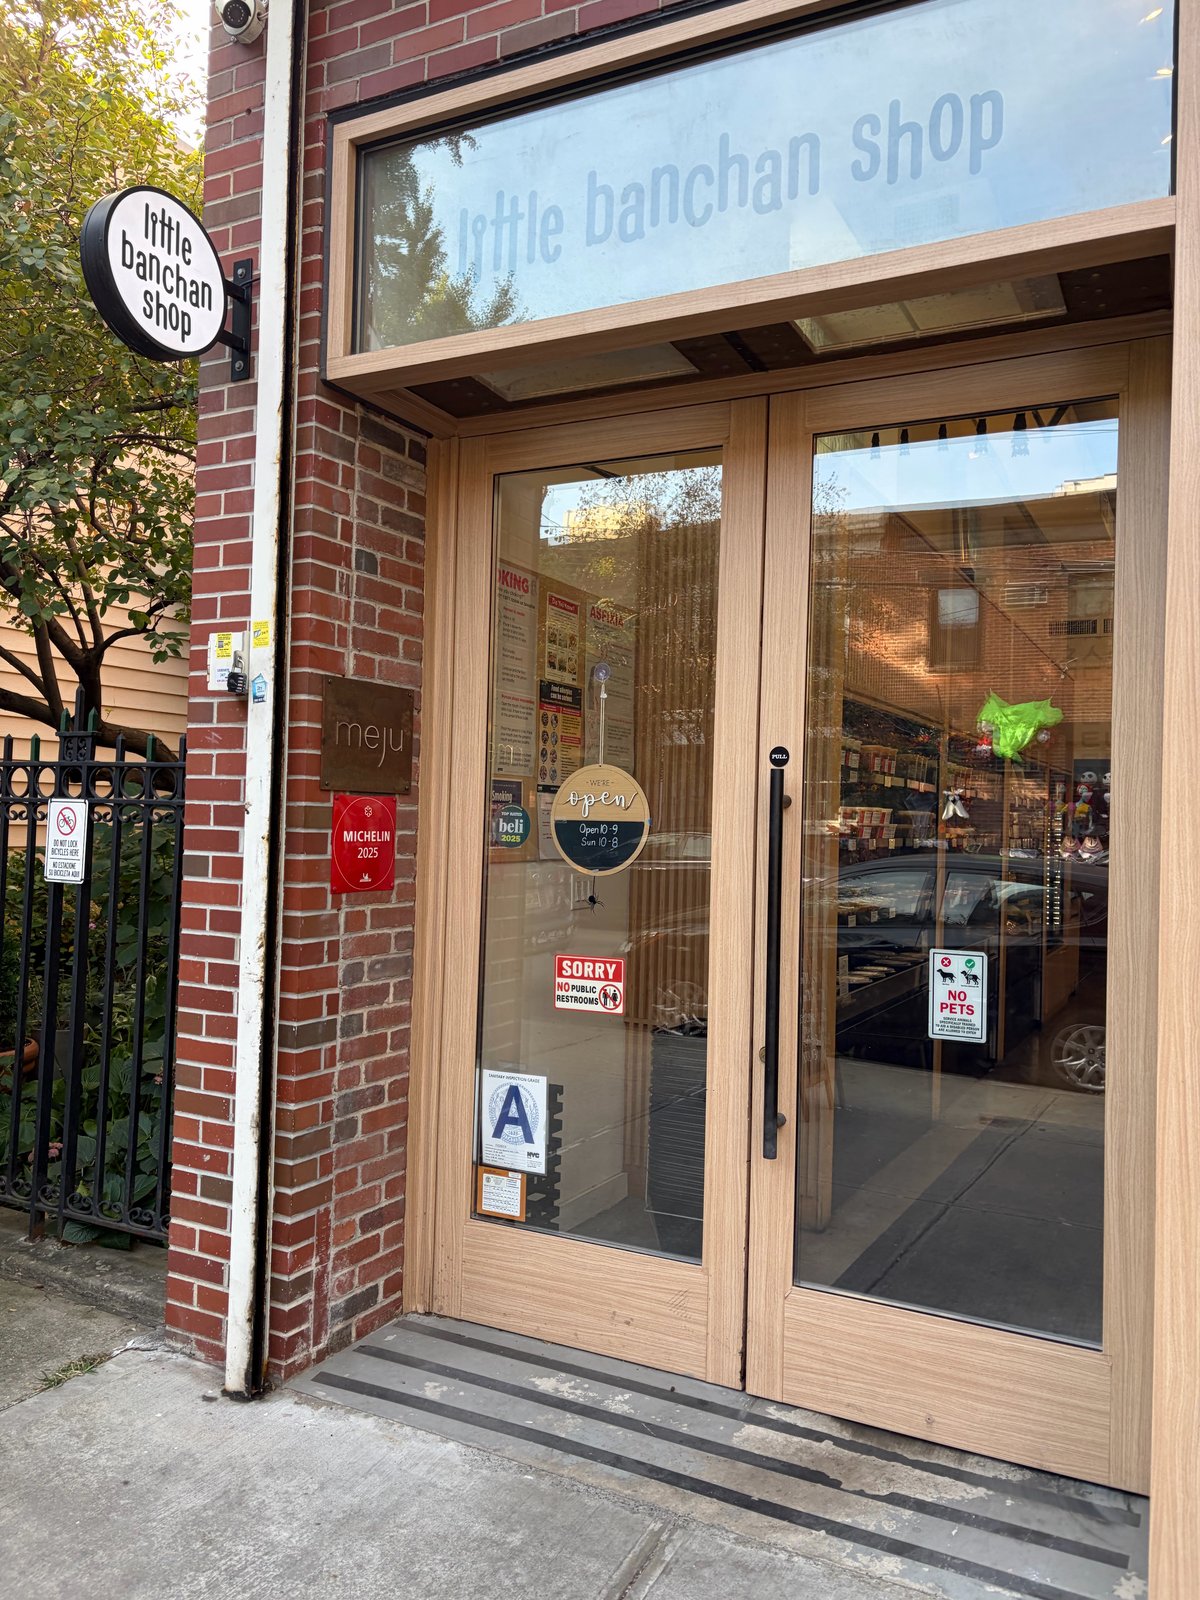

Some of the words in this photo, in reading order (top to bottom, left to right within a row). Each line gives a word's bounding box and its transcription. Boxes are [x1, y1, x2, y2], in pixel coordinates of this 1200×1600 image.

[458, 189, 565, 284] little
[585, 132, 821, 247] banchan
[850, 89, 1004, 185] shop
[144, 202, 192, 266] little
[121, 229, 212, 312] banchan
[142, 289, 192, 343] shop
[335, 721, 404, 768] meju
[563, 790, 638, 818] open
[499, 818, 524, 834] beli
[579, 823, 599, 837] Open
[343, 830, 391, 842] MICHELIN
[501, 834, 521, 843] 2025
[581, 836, 596, 847] Sun
[53, 839, 59, 847] DO
[68, 840, 78, 848] LOCK
[51, 848, 69, 856] BICYCLES
[70, 849, 80, 857] HERE
[357, 847, 379, 859] 2025
[562, 960, 617, 980] SORRY
[557, 982, 570, 992] NO
[571, 985, 597, 994] PUBLIC
[557, 994, 599, 1006] RESTROOMS
[947, 990, 967, 1002] NO
[940, 1002, 975, 1016] PETS
[492, 1084, 534, 1144] A
[527, 1151, 540, 1159] NYC
